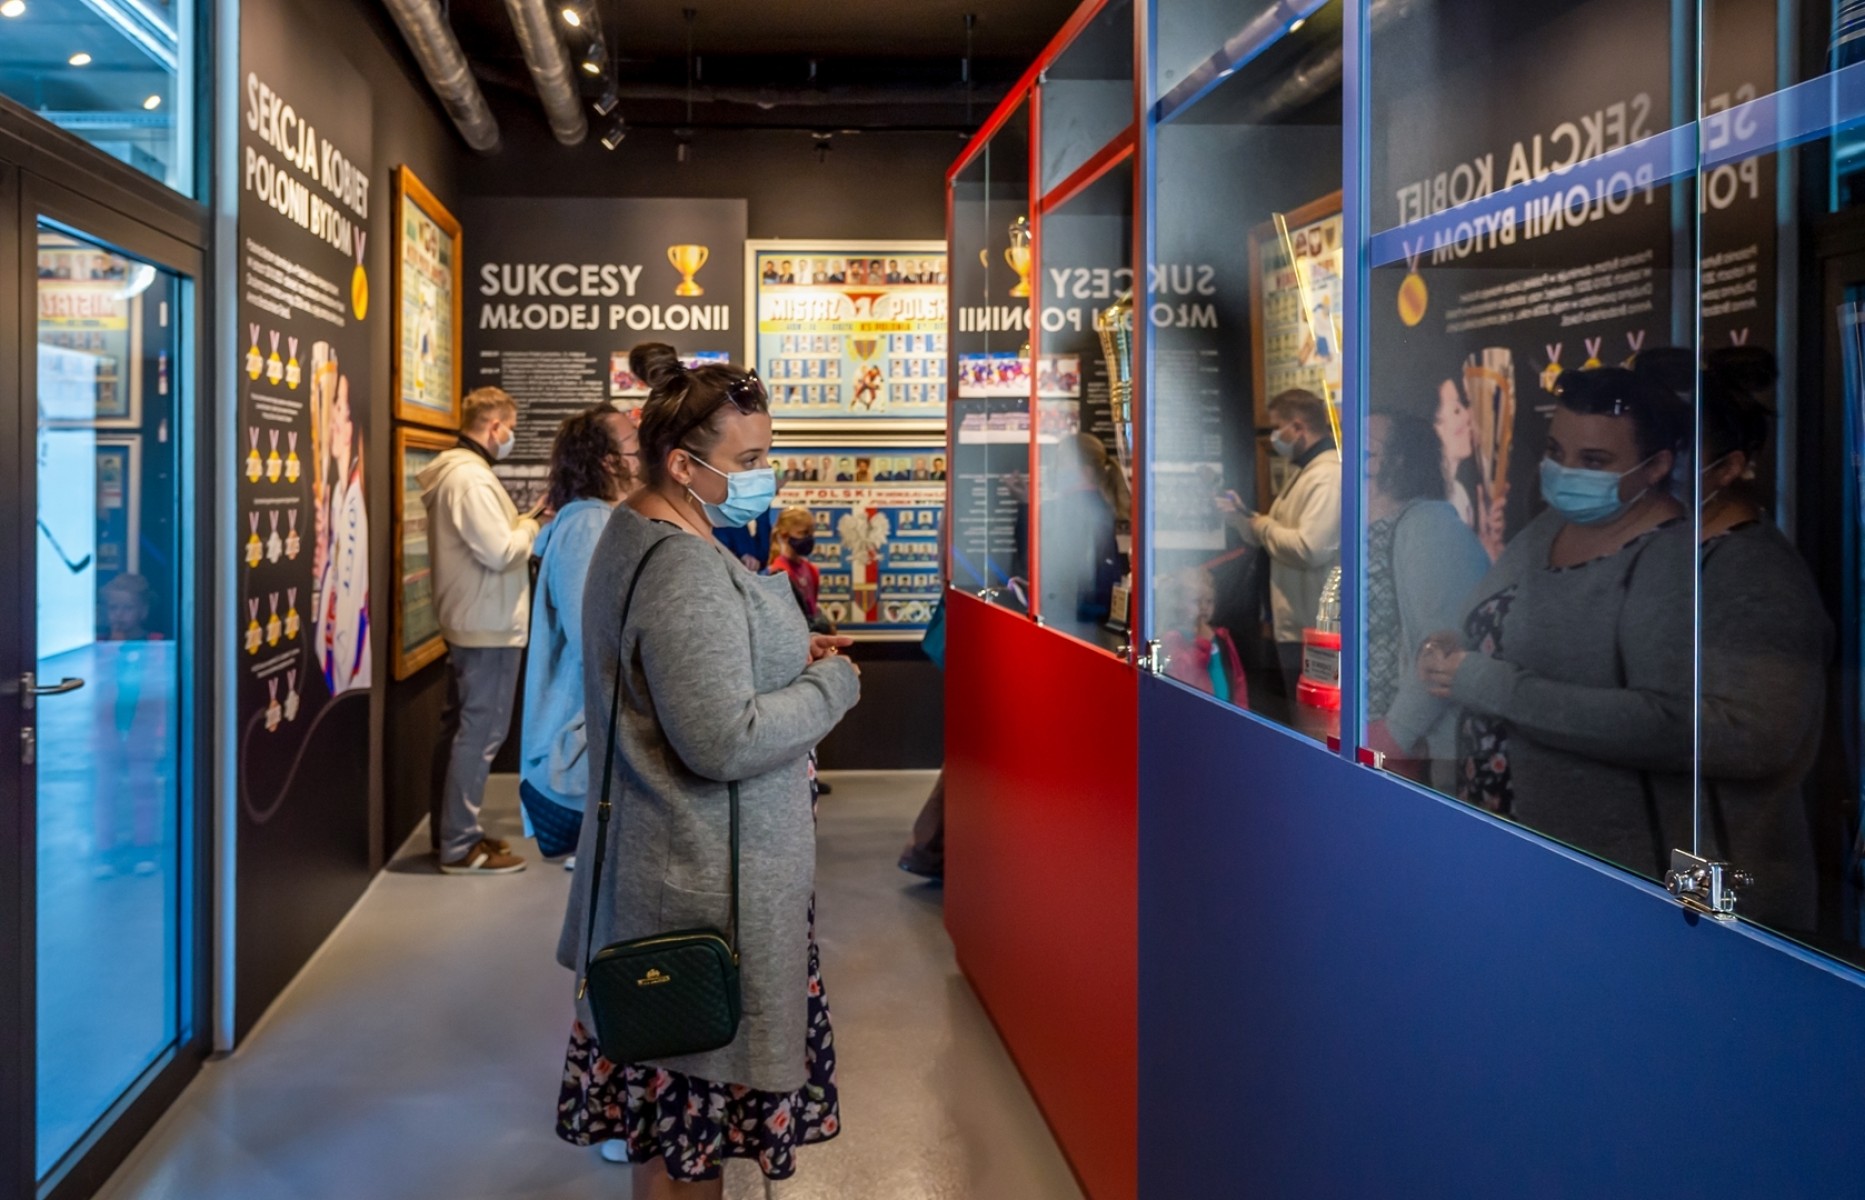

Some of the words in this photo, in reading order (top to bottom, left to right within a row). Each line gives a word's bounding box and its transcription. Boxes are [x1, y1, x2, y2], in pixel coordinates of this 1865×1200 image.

[247, 71, 319, 181] SEKCJA
[321, 138, 370, 219] KOBIET
[245, 145, 309, 228] POLONII
[309, 193, 353, 257] BYTOM
[480, 262, 643, 298] SUKCESY
[480, 303, 601, 330] MŁODEJ
[608, 304, 730, 331] POLONII
